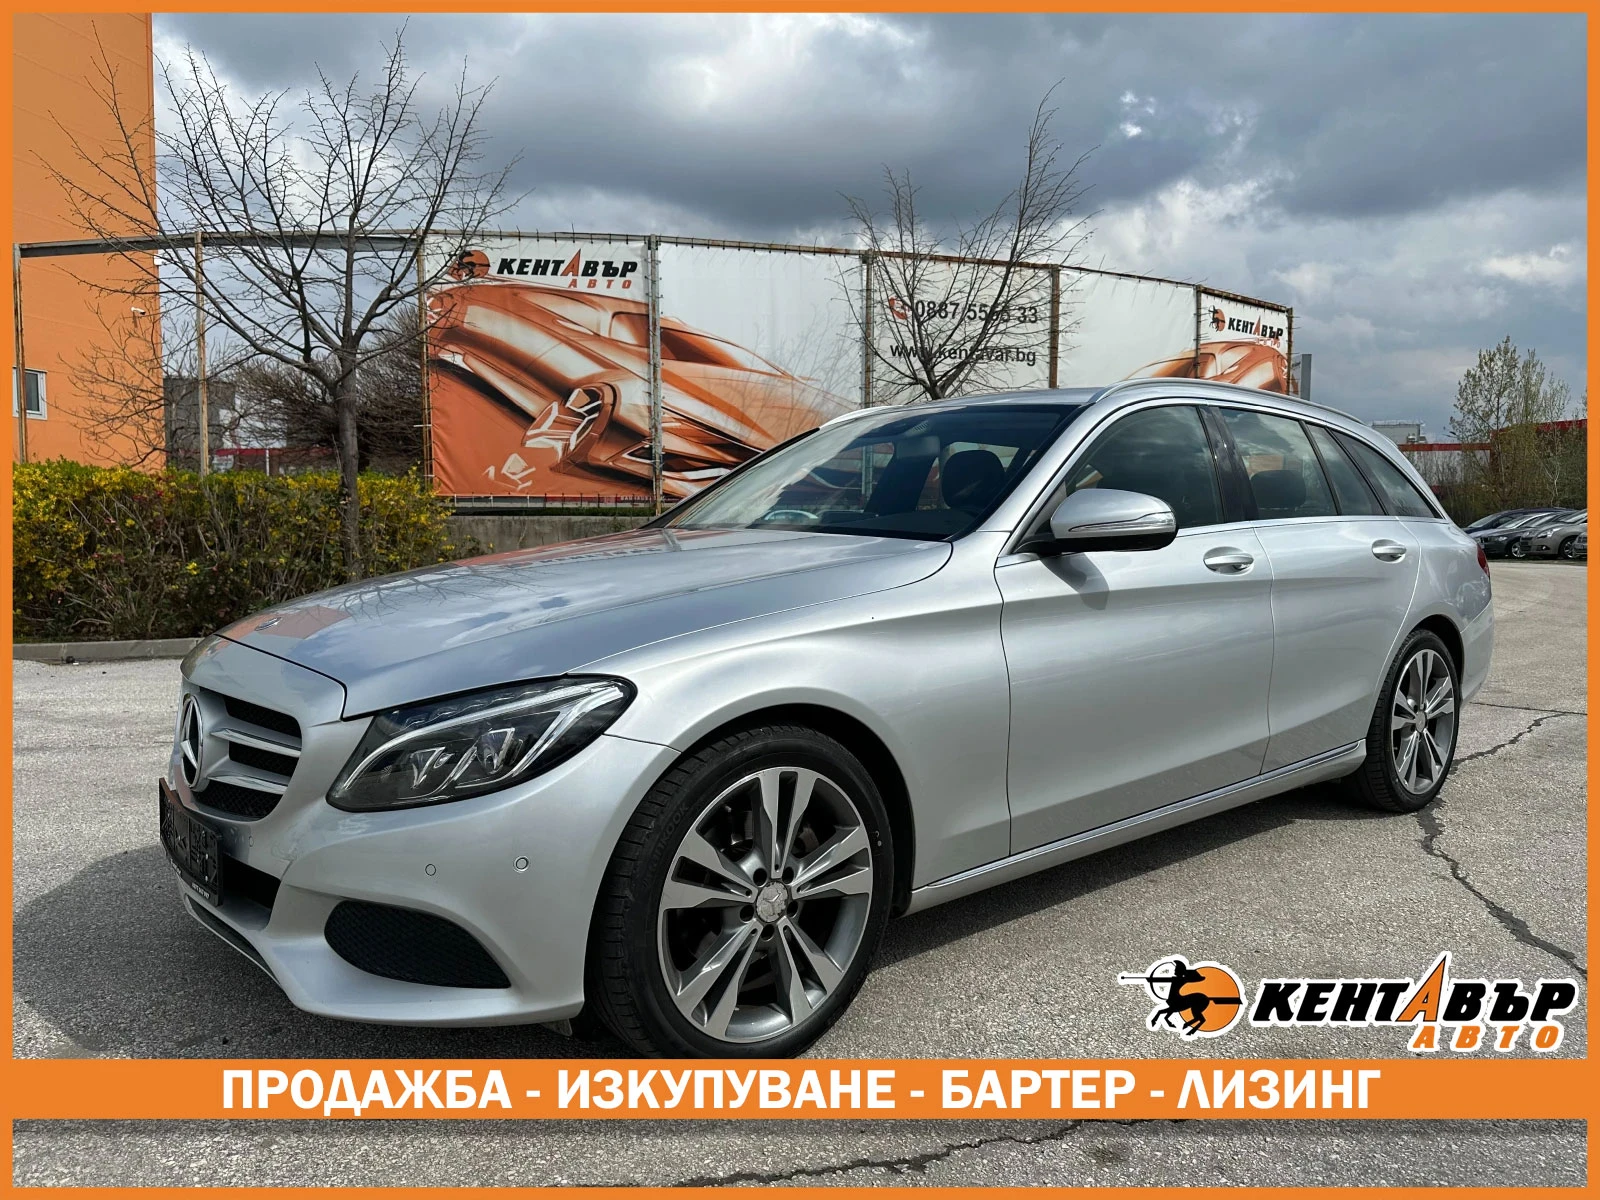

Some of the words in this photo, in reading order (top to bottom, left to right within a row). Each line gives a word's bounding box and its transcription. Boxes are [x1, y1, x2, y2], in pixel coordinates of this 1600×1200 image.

[497, 249, 638, 278] КЕНТАВЪР
[568, 278, 632, 289] АВТО
[915, 300, 960, 320] 0887
[1017, 306, 1038, 324] 33
[1228, 315, 1284, 340] КЕНТАВЪР
[890, 344, 1036, 367] wwkenavar.bg
